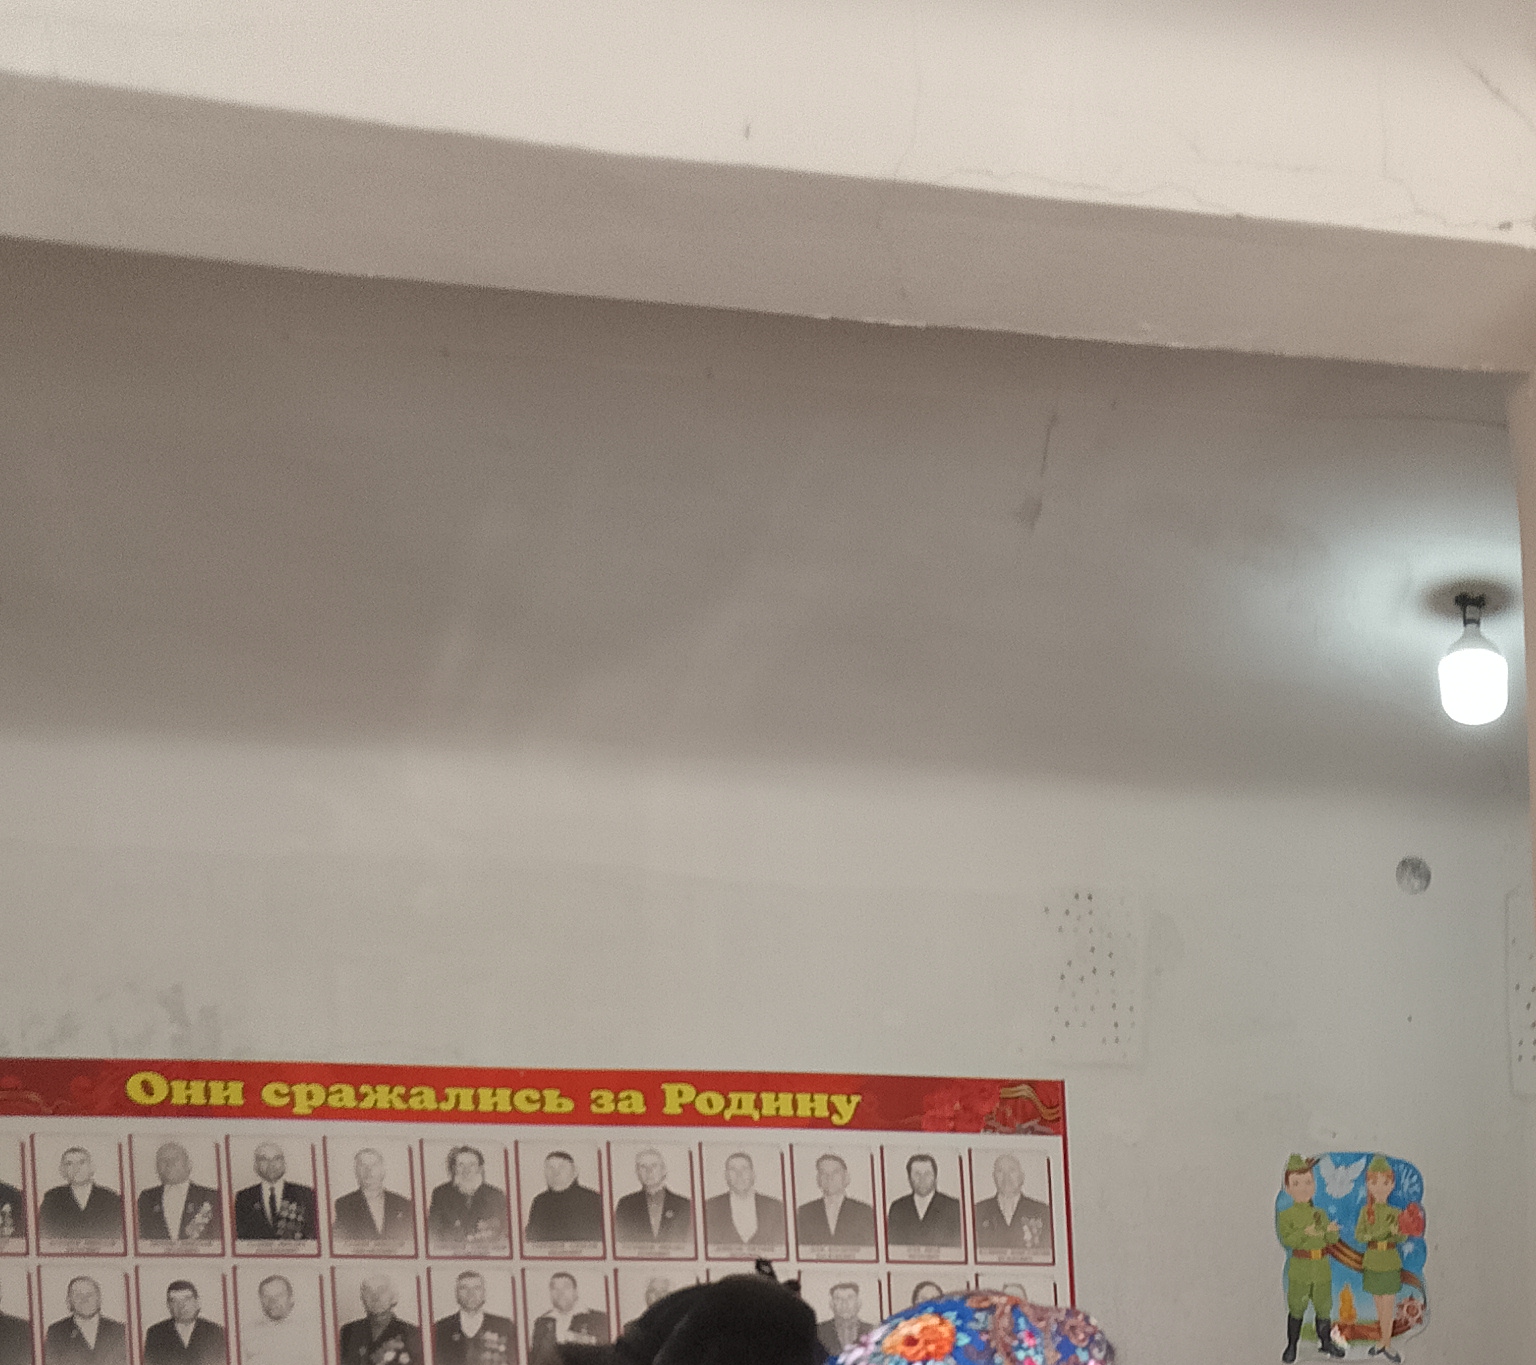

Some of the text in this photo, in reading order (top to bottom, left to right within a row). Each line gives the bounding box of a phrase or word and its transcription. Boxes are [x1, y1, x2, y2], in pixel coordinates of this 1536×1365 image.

[125, 1070, 863, 1126] Они сражались за Родину
